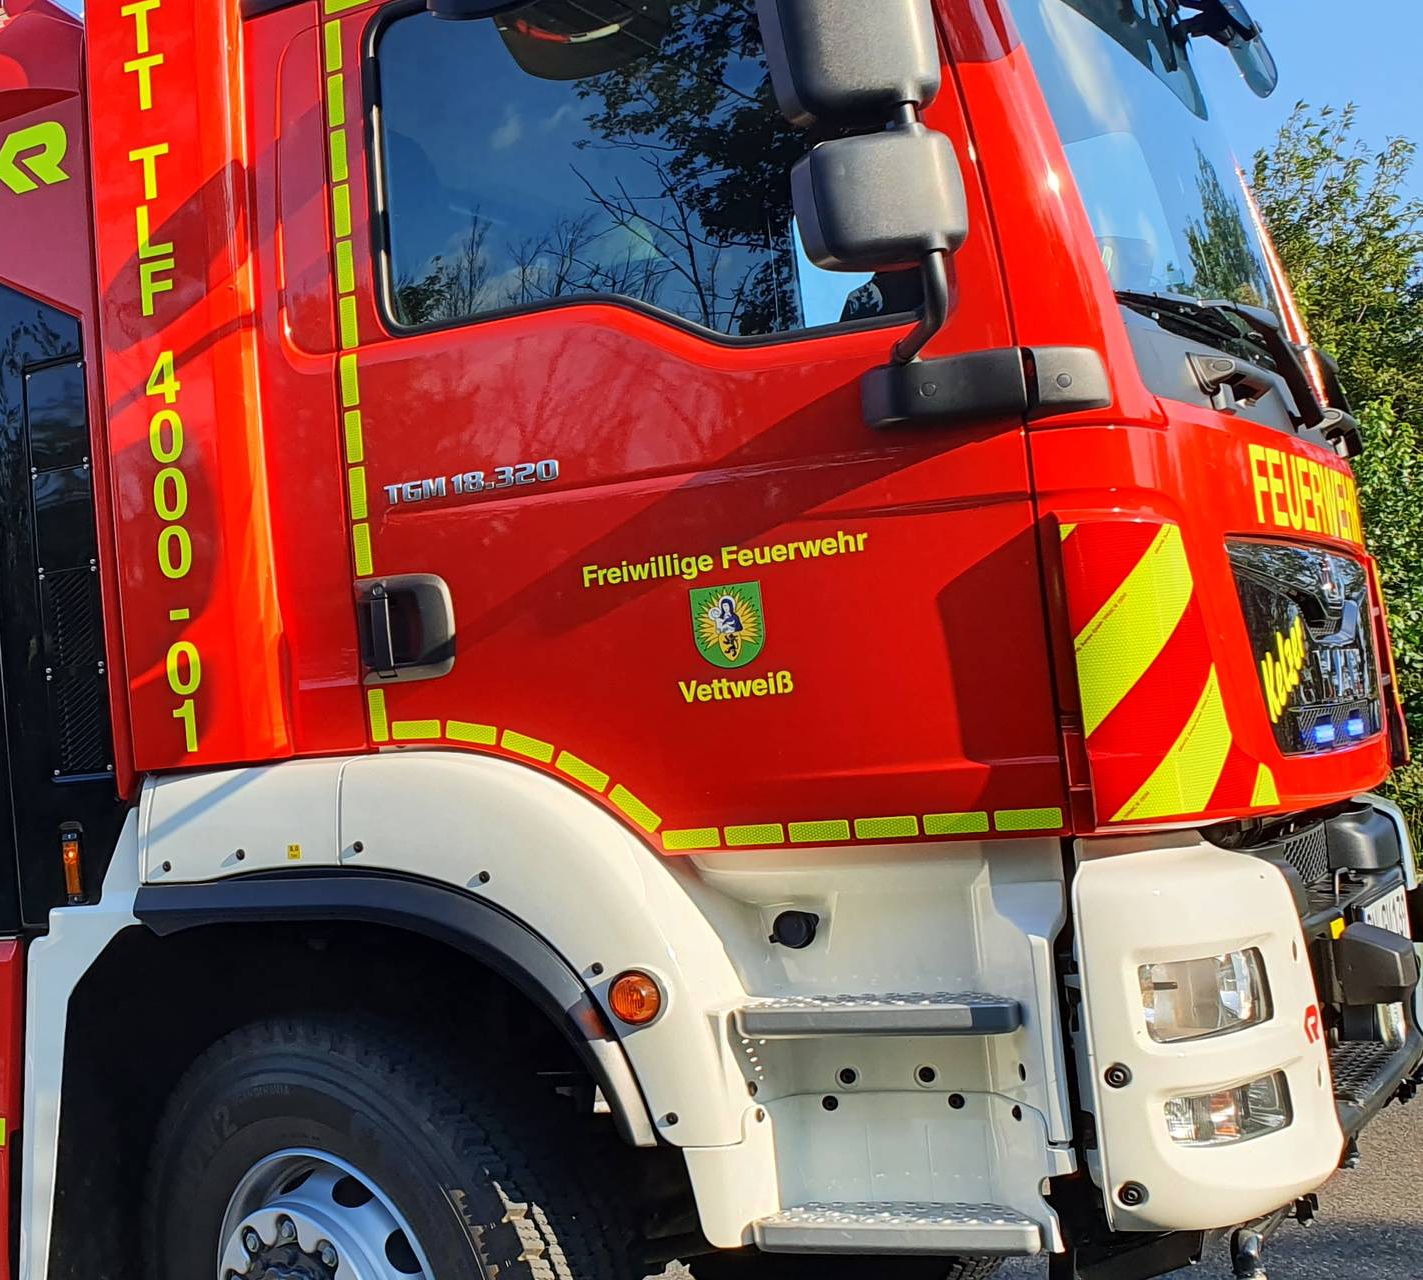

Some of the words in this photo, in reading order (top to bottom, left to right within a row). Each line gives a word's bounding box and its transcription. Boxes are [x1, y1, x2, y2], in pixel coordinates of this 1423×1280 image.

[129, 143, 176, 318] TLF
[383, 469, 447, 506] TGM
[451, 458, 560, 496] 18.320
[582, 554, 714, 588] Freiwillige
[719, 530, 869, 569] Feuerwehr
[678, 670, 795, 703] Vettweiß
